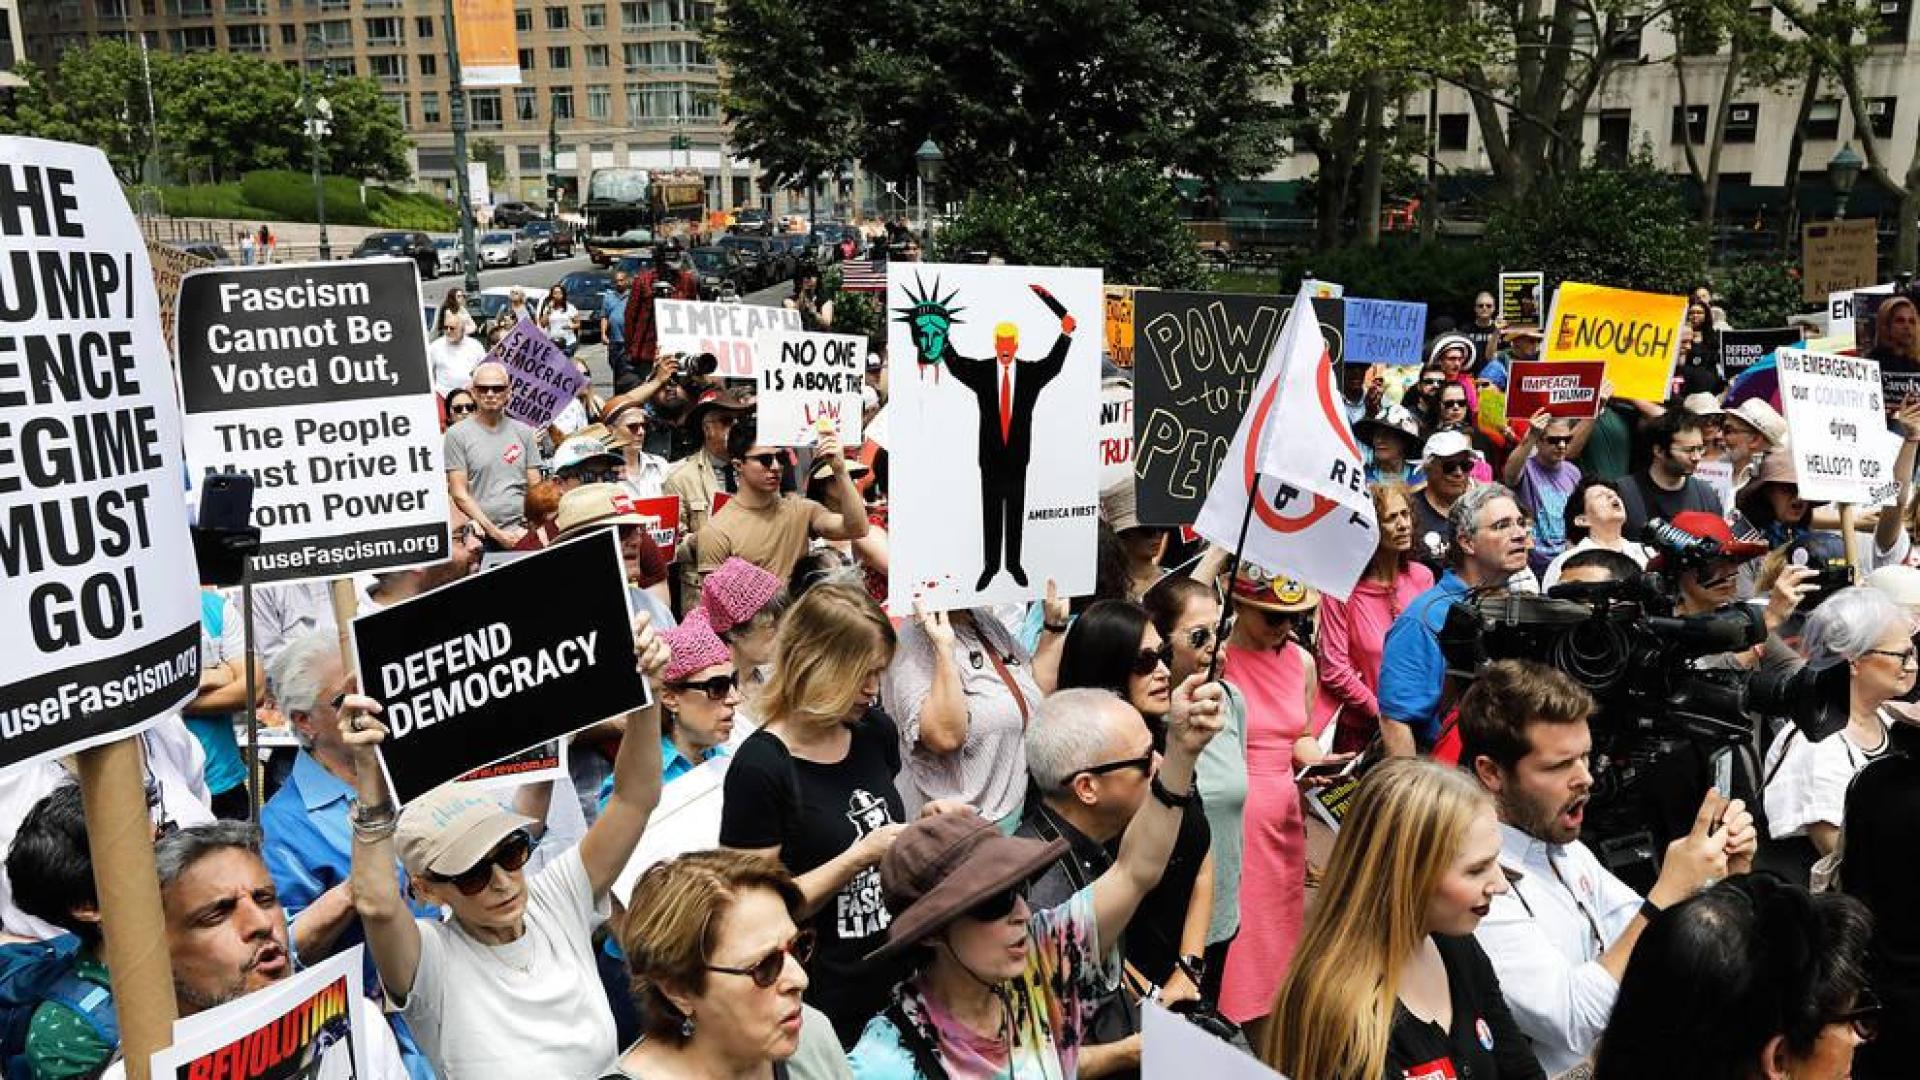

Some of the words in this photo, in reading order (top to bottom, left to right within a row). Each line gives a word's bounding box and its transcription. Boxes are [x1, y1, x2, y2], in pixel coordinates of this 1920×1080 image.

[220, 279, 372, 313] Fascism
[1348, 302, 1418, 332] IMPEACH
[207, 321, 337, 355] Cannot
[348, 315, 393, 344] Be
[511, 332, 552, 361] SAVE
[1555, 313, 1673, 359] ENOUGH
[781, 338, 817, 367] NO
[823, 338, 856, 369] ONE
[1802, 354, 1869, 381] EMERGENCY
[211, 358, 317, 395] Voted
[329, 355, 399, 387] Out,
[765, 368, 785, 391] IS
[792, 371, 843, 395] ABOVE
[845, 373, 864, 395] THE
[1523, 375, 1578, 390] IMPEACH
[508, 373, 558, 410] PEACH
[1204, 380, 1230, 415] to
[1552, 388, 1593, 401] TRUMP
[1814, 384, 1865, 408] COUNTRY
[506, 395, 552, 423] RUMP
[804, 400, 841, 426] LAW
[214, 423, 283, 453] The
[294, 411, 411, 447] People
[1829, 417, 1857, 443] dying
[204, 459, 299, 490] ust
[308, 452, 397, 484] Drive
[408, 445, 433, 473] It
[1859, 458, 1881, 478] GOP
[250, 501, 311, 527] om
[322, 488, 429, 521] Power
[1027, 508, 1069, 520] AMERICA
[1072, 505, 1097, 517] FIRST
[29, 566, 144, 654] GO!
[381, 622, 512, 700] DEFEND
[387, 630, 599, 740] DEMOCRACY
[186, 974, 348, 1080] REVOLUTION
